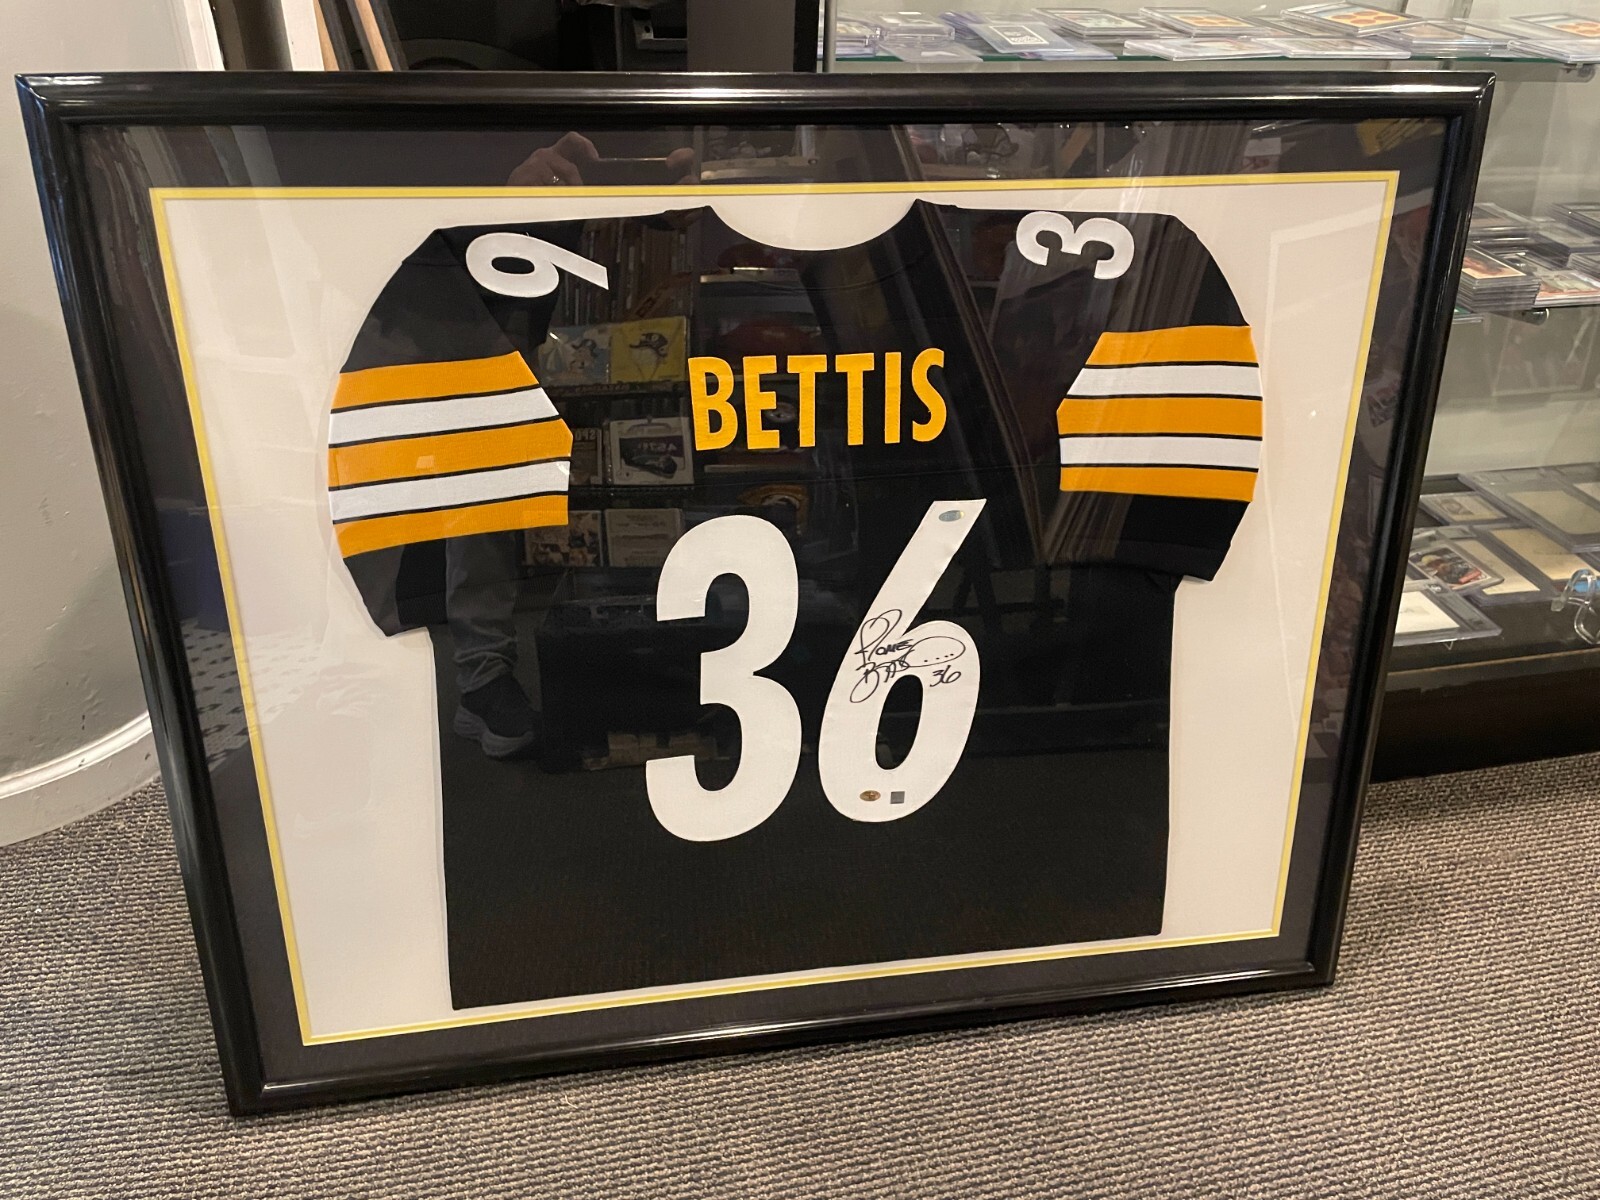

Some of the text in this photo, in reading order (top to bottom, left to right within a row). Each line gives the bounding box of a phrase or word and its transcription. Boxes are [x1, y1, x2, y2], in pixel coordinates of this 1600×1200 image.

[688, 348, 947, 451] BETTIS
[645, 498, 987, 842] 36
[929, 664, 962, 688] 36
